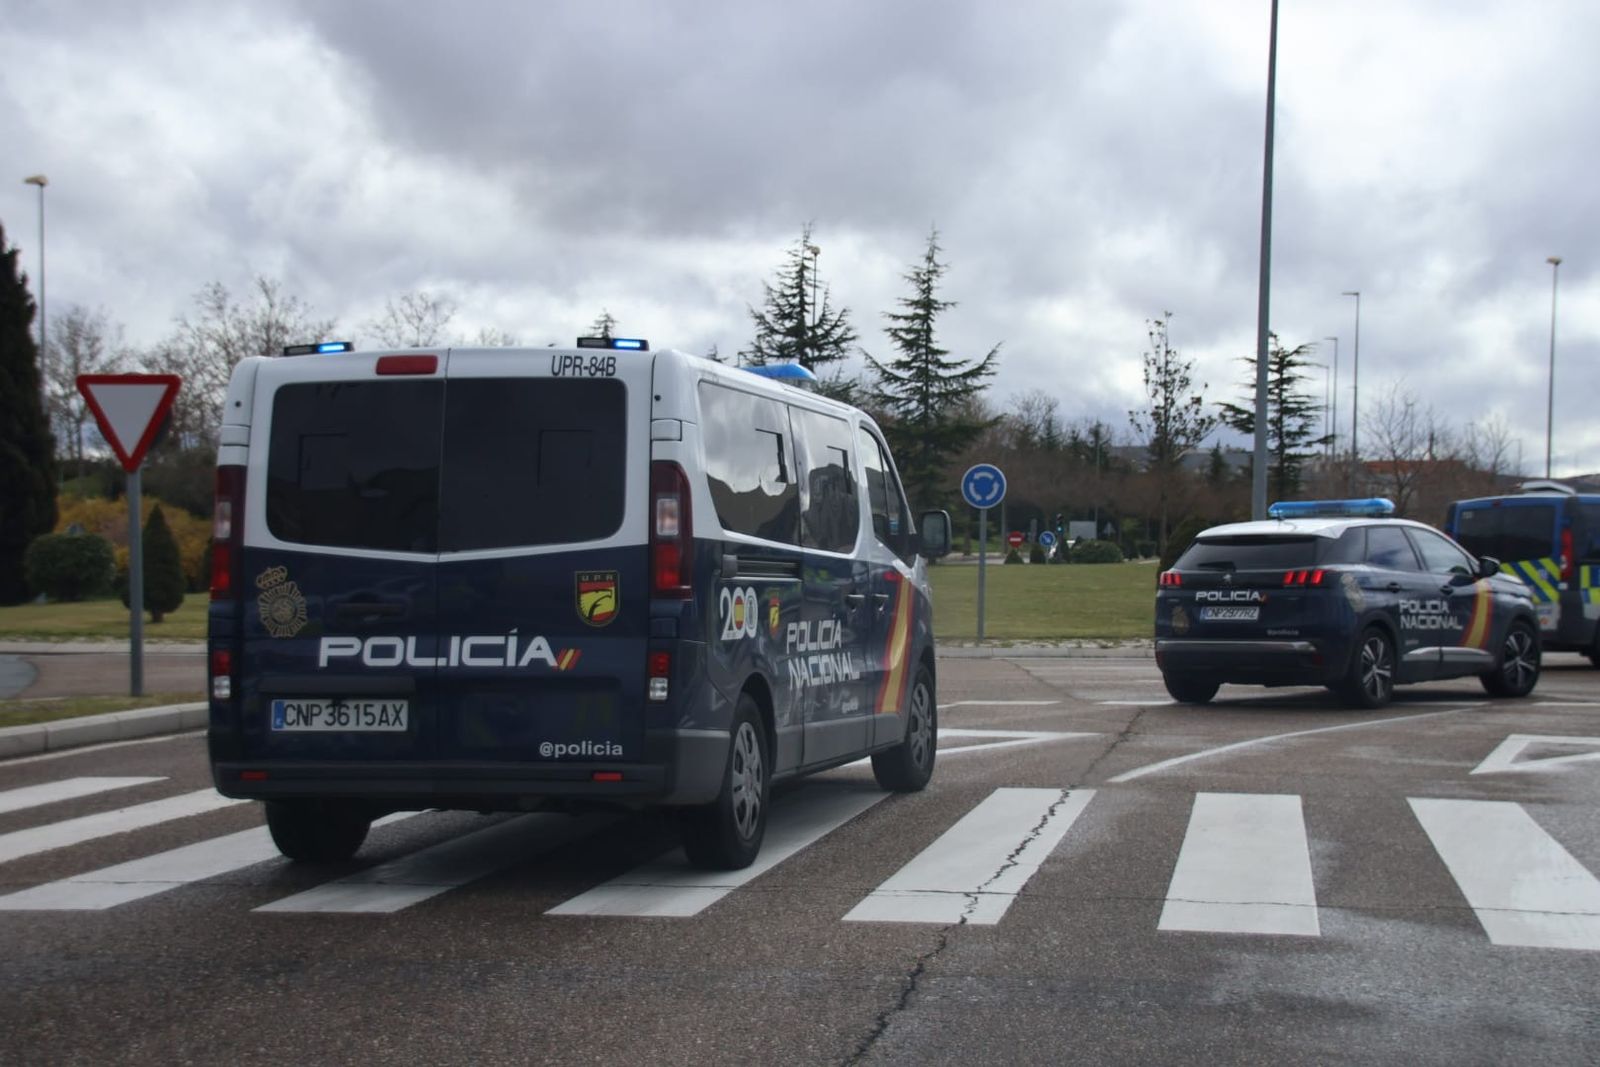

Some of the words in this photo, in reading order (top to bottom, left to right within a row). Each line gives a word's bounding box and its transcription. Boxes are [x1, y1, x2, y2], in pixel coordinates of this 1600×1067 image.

[551, 355, 617, 377] UPR-84B
[1400, 614, 1464, 630] NACIONAL
[319, 628, 559, 668] POLICÍA
[787, 652, 861, 692] NACIONAL
[539, 740, 623, 758] @policia
